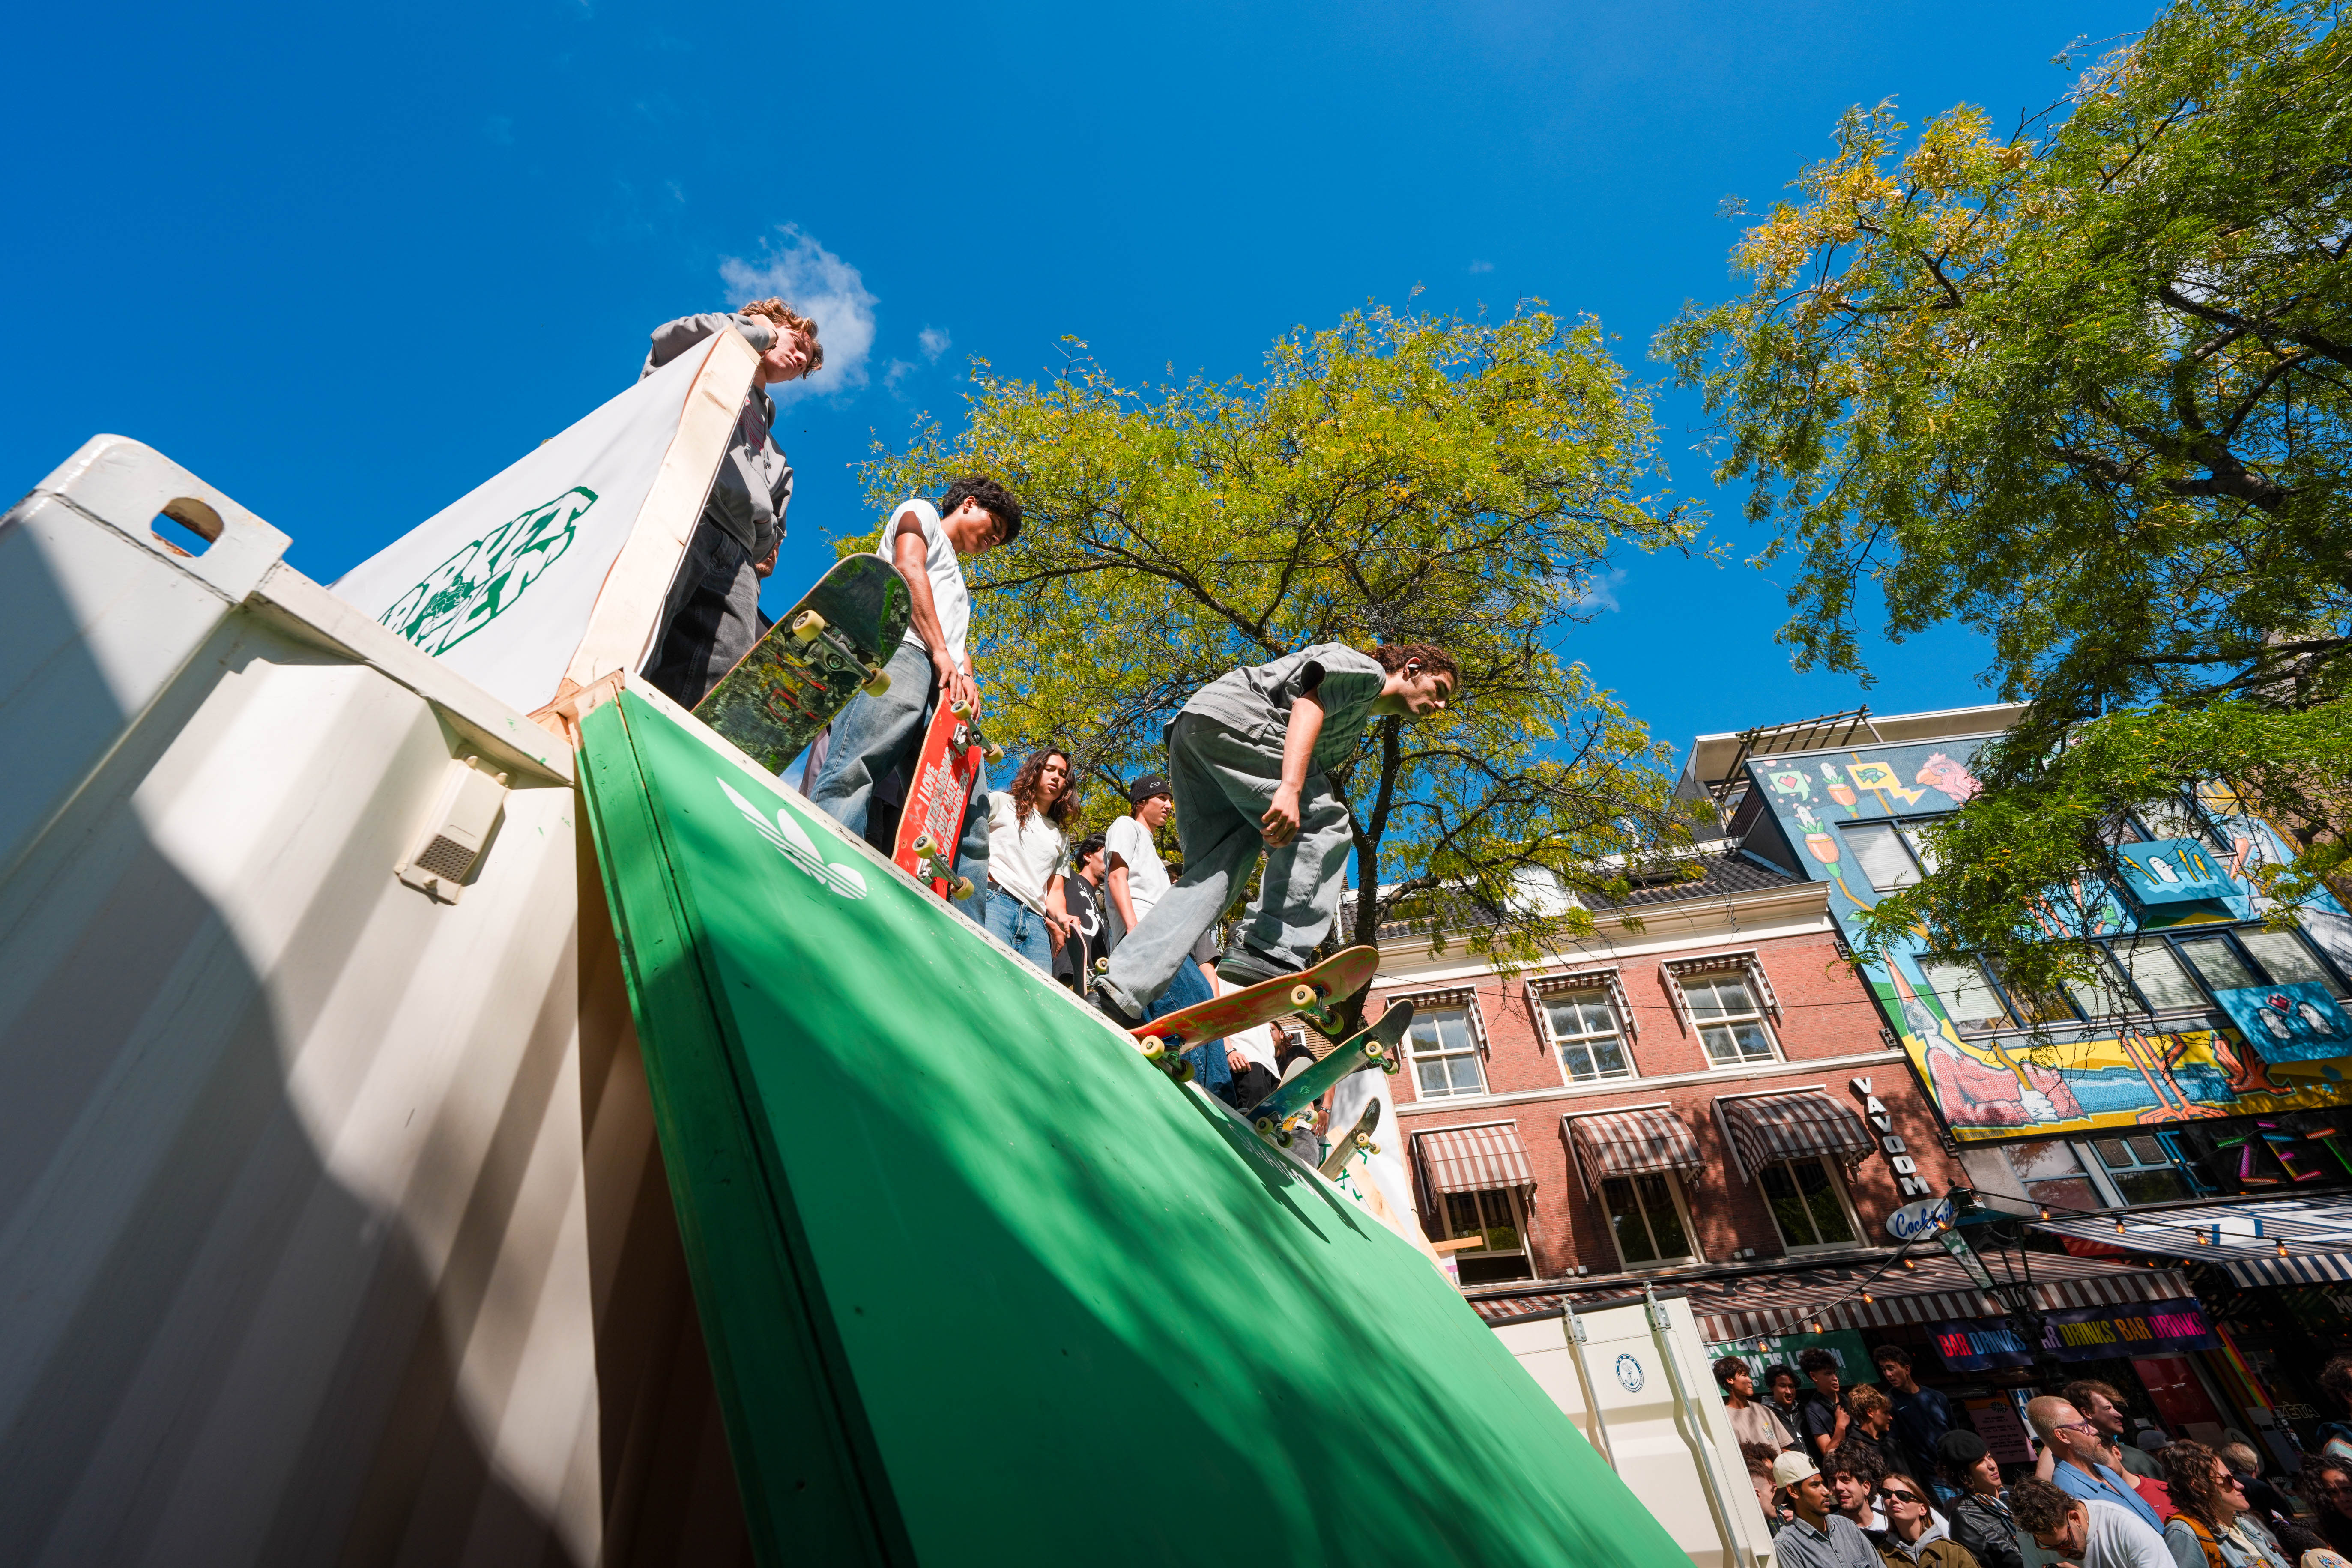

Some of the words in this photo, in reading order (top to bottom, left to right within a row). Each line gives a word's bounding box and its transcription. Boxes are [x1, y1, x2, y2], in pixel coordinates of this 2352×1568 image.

[920, 762, 938, 798] LOVE
[921, 747, 957, 836] KATEBOARDING,
[936, 805, 950, 838] BUT
[943, 774, 958, 811] HATE
[941, 768, 970, 857] KATEBOARDERS.
[1851, 1077, 1931, 1195] VAVOOM
[1896, 1200, 1954, 1237] Cocktail
[1937, 1333, 1972, 1357] BAR
[1968, 1330, 2026, 1355] DRINKS
[2058, 1320, 2117, 1347] DRINKS
[2114, 1319, 2153, 1341] BAR
[2148, 1312, 2206, 1338] DRINKS
